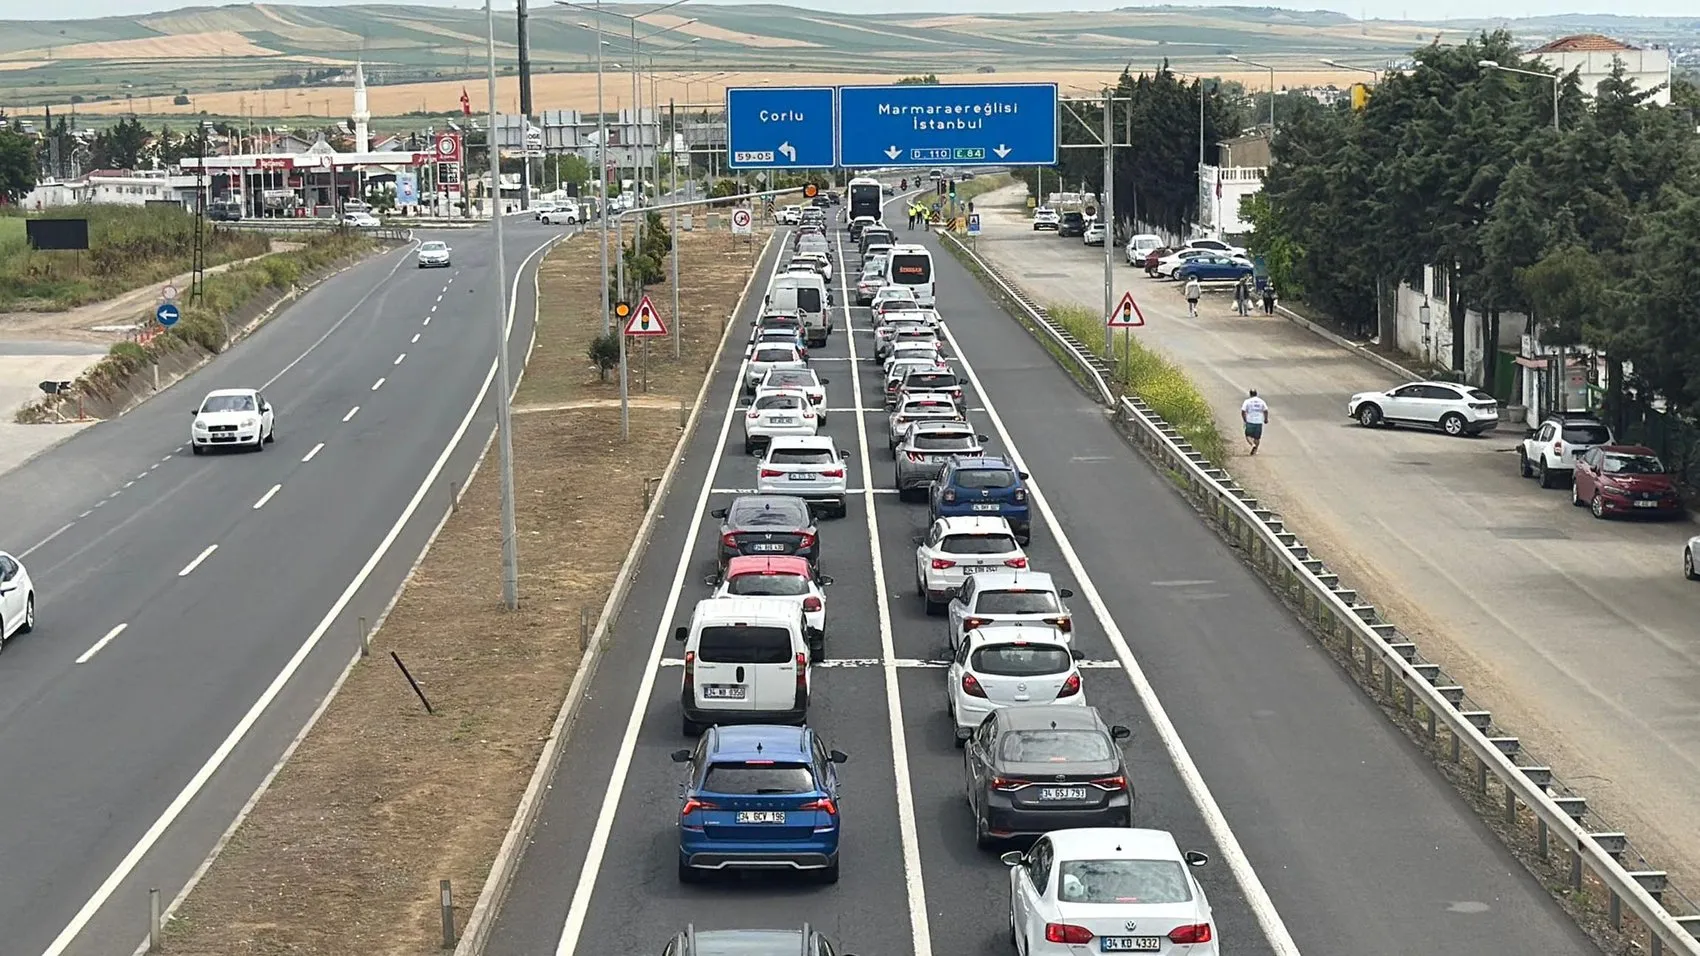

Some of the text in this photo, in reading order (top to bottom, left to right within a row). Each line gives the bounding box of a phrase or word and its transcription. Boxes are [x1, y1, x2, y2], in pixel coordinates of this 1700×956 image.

[878, 102, 1018, 116] Marmaraereğlisi
[759, 109, 804, 123] Çorlu
[913, 116, 982, 130] İstanbul
[737, 152, 772, 161] 59-05
[1043, 788, 1085, 798] 34 GSJ 793
[739, 811, 785, 821] 34 GCV 196
[1107, 937, 1118, 948] 34
[1136, 937, 1158, 948] 4332
